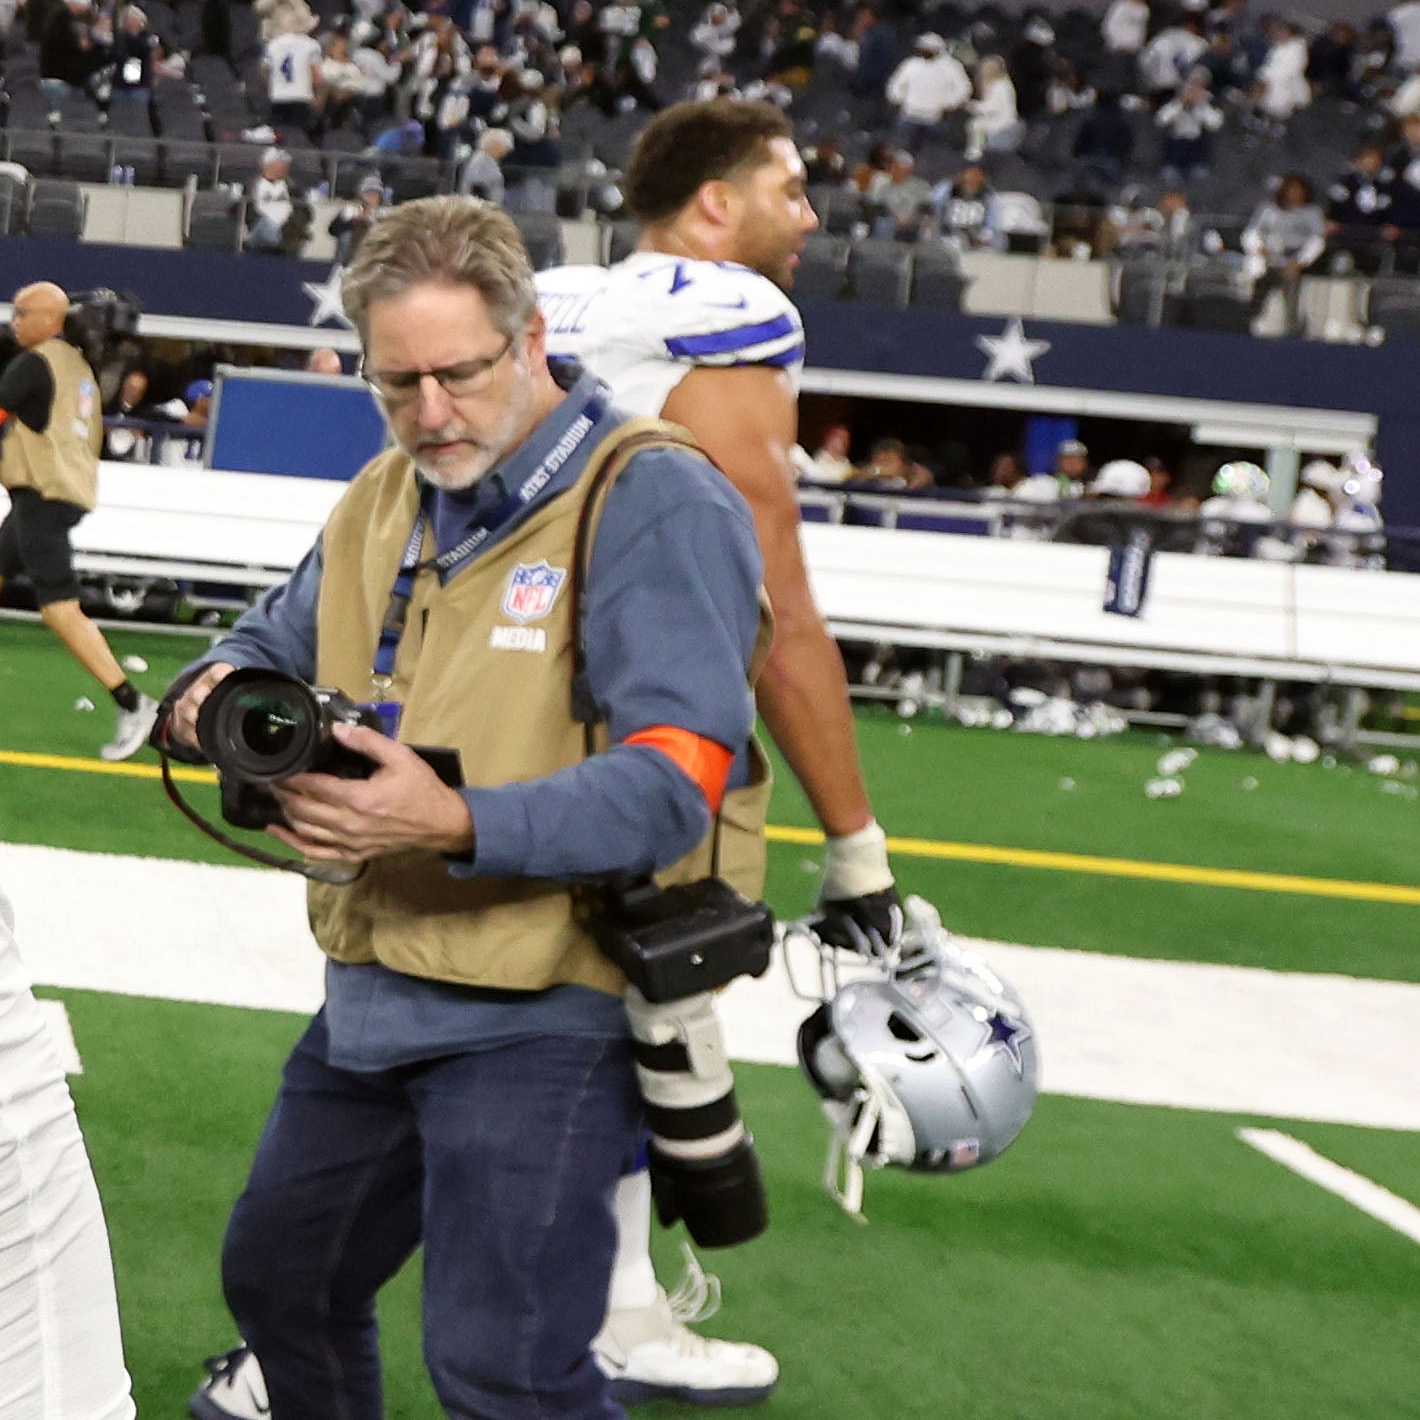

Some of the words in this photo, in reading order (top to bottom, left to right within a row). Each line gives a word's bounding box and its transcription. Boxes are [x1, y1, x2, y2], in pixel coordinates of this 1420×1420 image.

[543, 413, 594, 475] STADIUM
[510, 585, 547, 614] NFL
[490, 625, 547, 653] MEDIA
